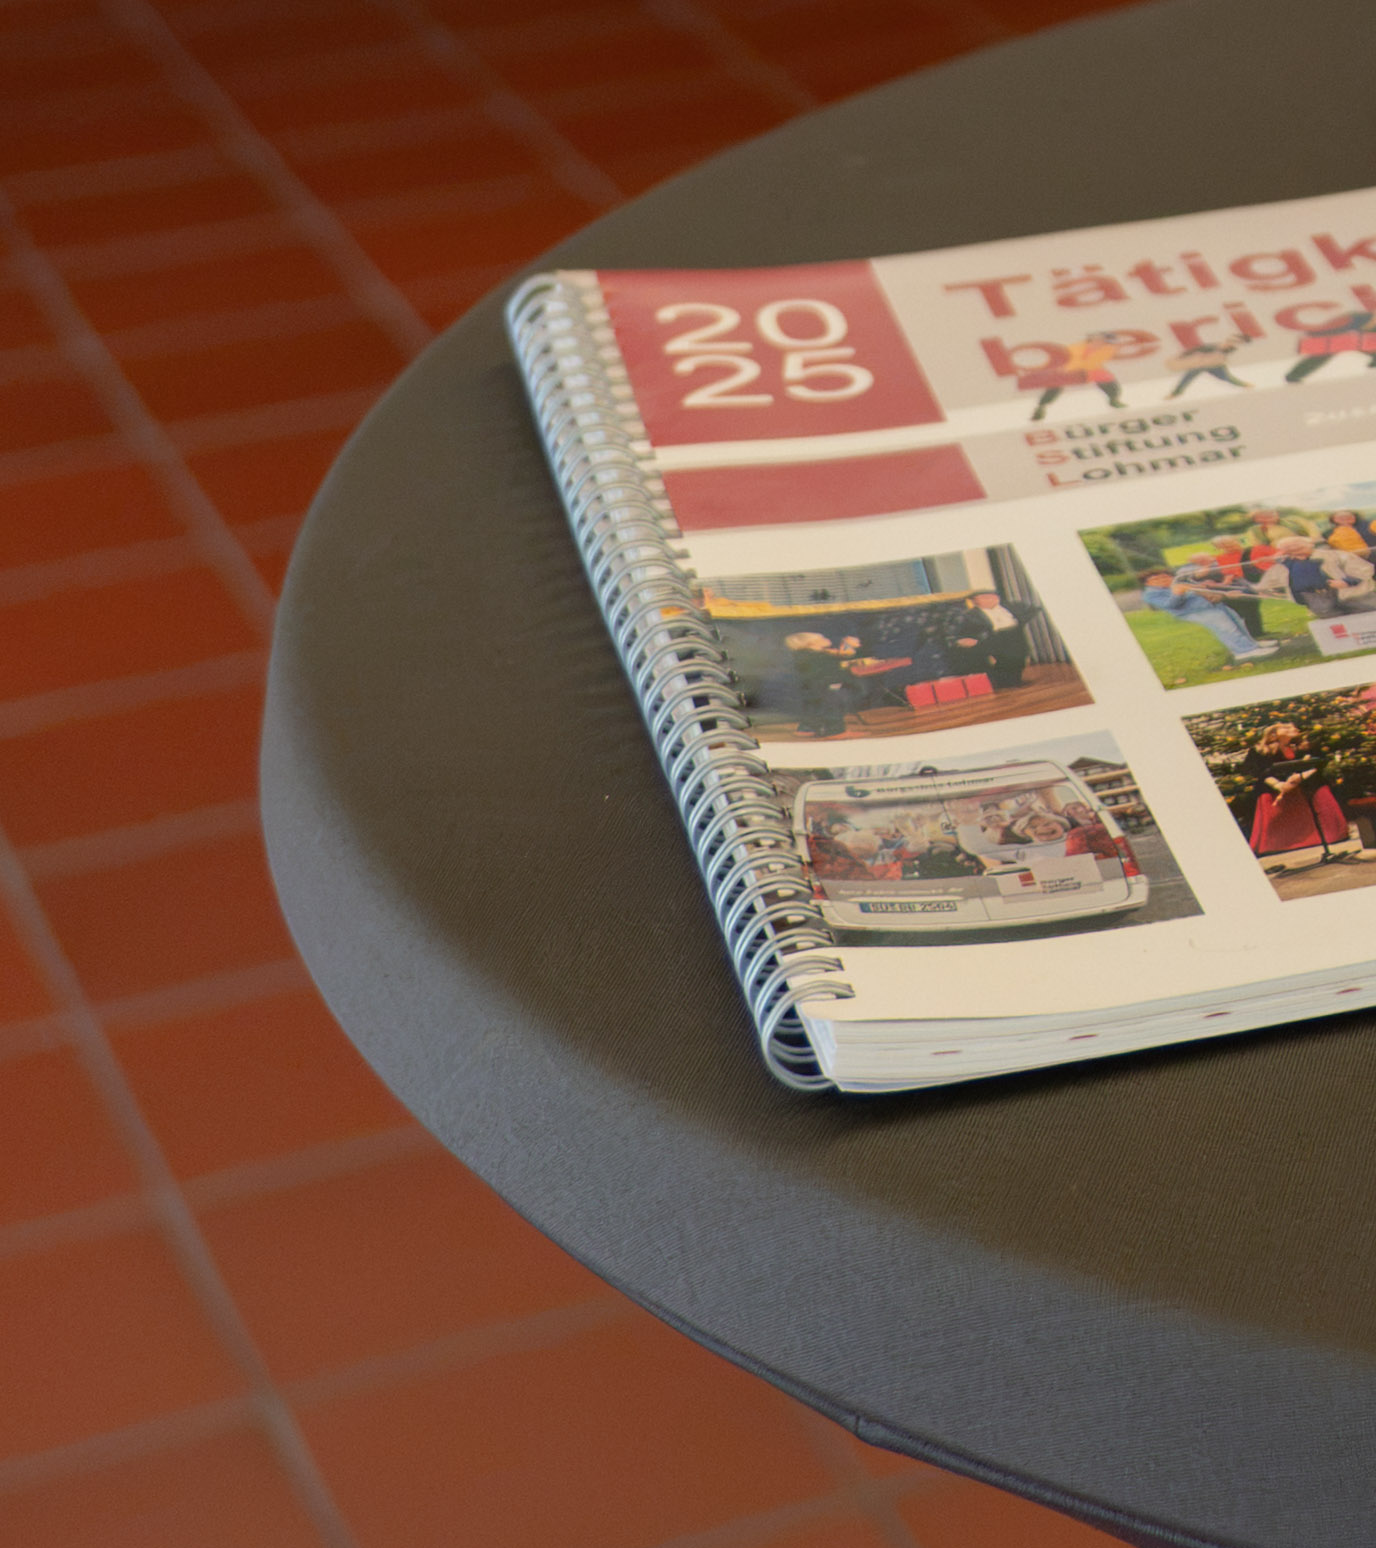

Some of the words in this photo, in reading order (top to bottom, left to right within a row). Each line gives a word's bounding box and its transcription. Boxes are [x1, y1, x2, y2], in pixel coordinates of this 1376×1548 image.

[655, 299, 853, 355] 20
[673, 347, 875, 407] 25
[1024, 408, 1199, 447] Bürger
[1036, 424, 1241, 466] Stiftung
[1047, 444, 1247, 487] Lohmar
